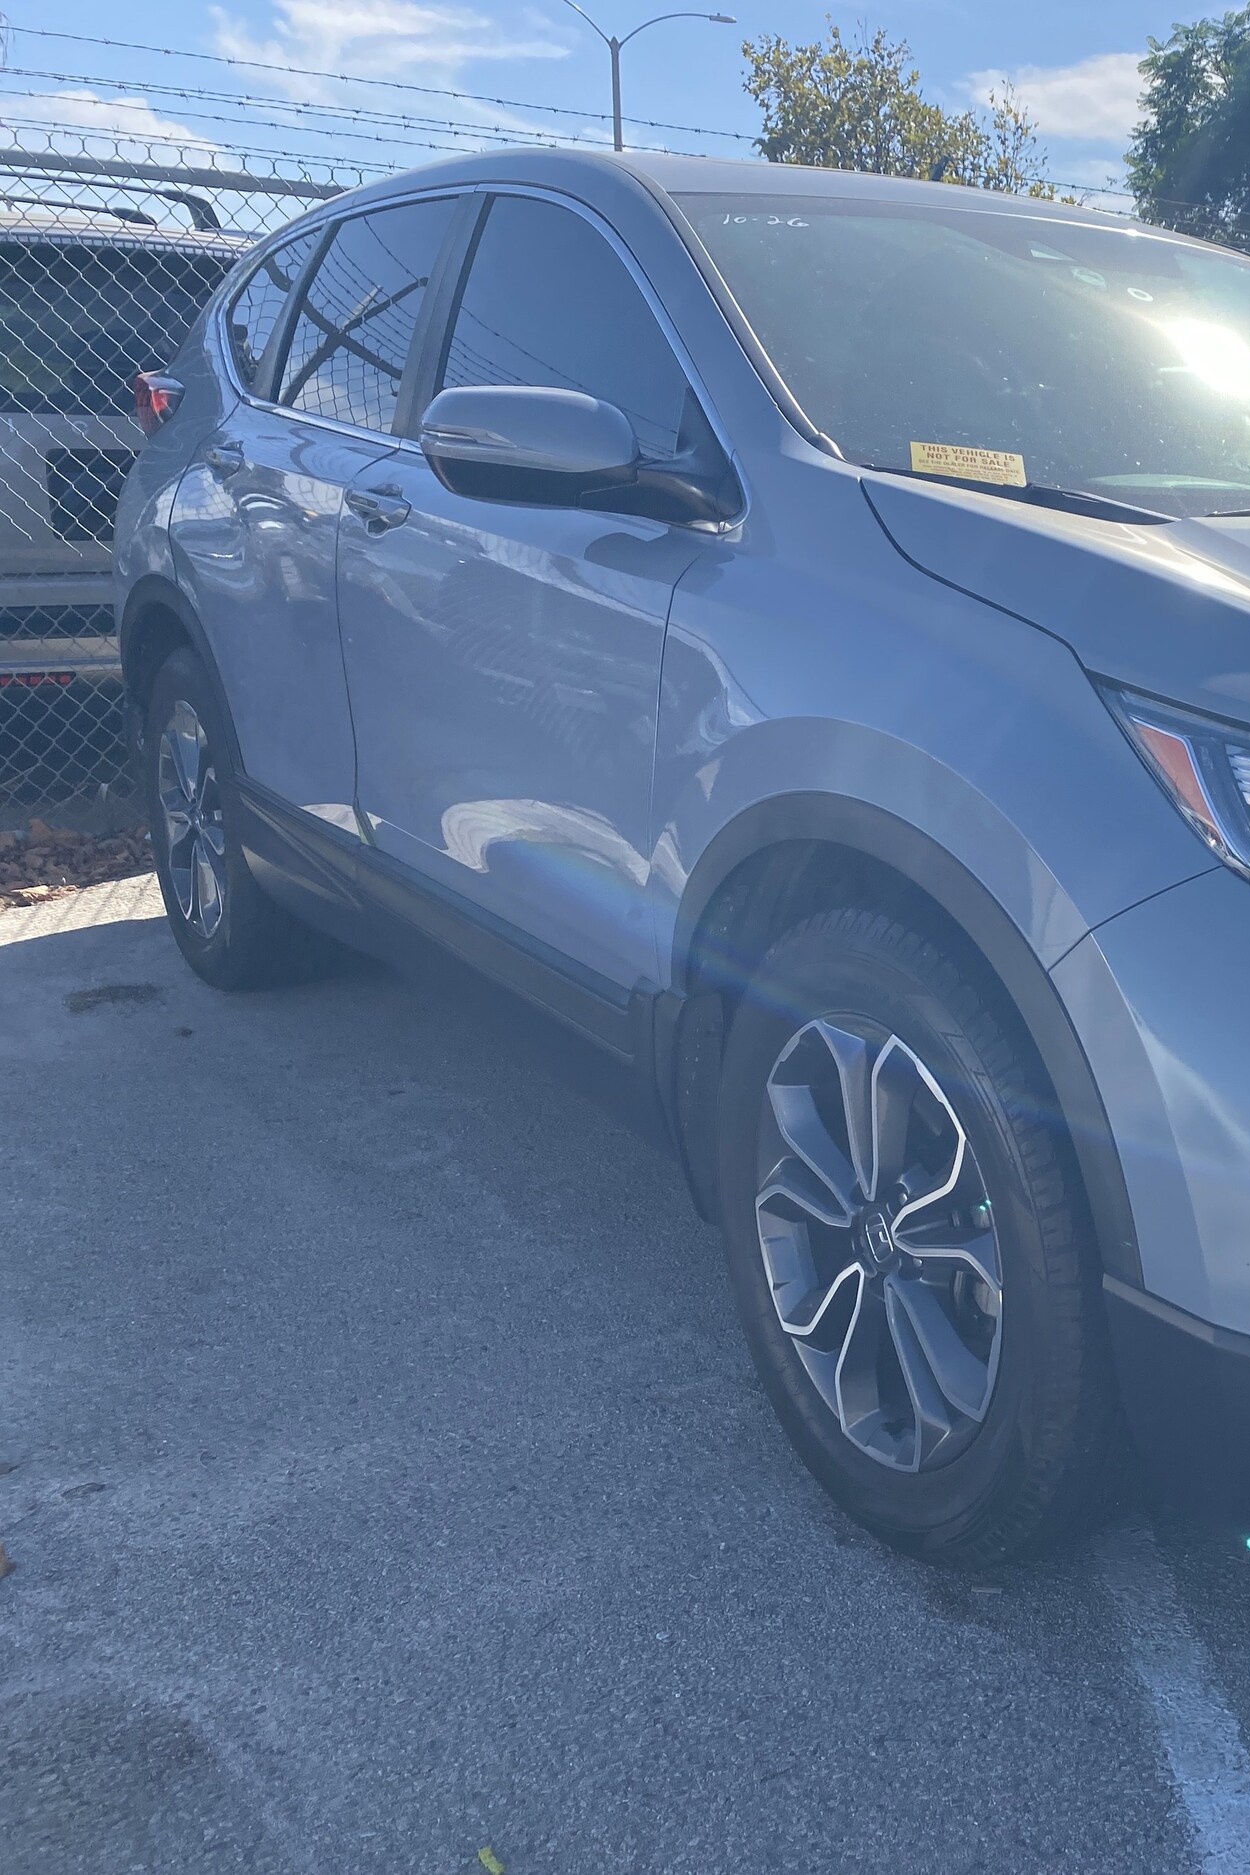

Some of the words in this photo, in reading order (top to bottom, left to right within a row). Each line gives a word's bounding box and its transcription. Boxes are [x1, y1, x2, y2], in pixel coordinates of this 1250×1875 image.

[722, 213, 810, 228] 10-26
[920, 444, 948, 453] THIS
[951, 447, 1000, 460] VEHICLE
[1004, 454, 1016, 462] IS
[926, 452, 950, 460] NOT
[955, 455, 977, 463] FOR
[981, 459, 1011, 468] SALE
